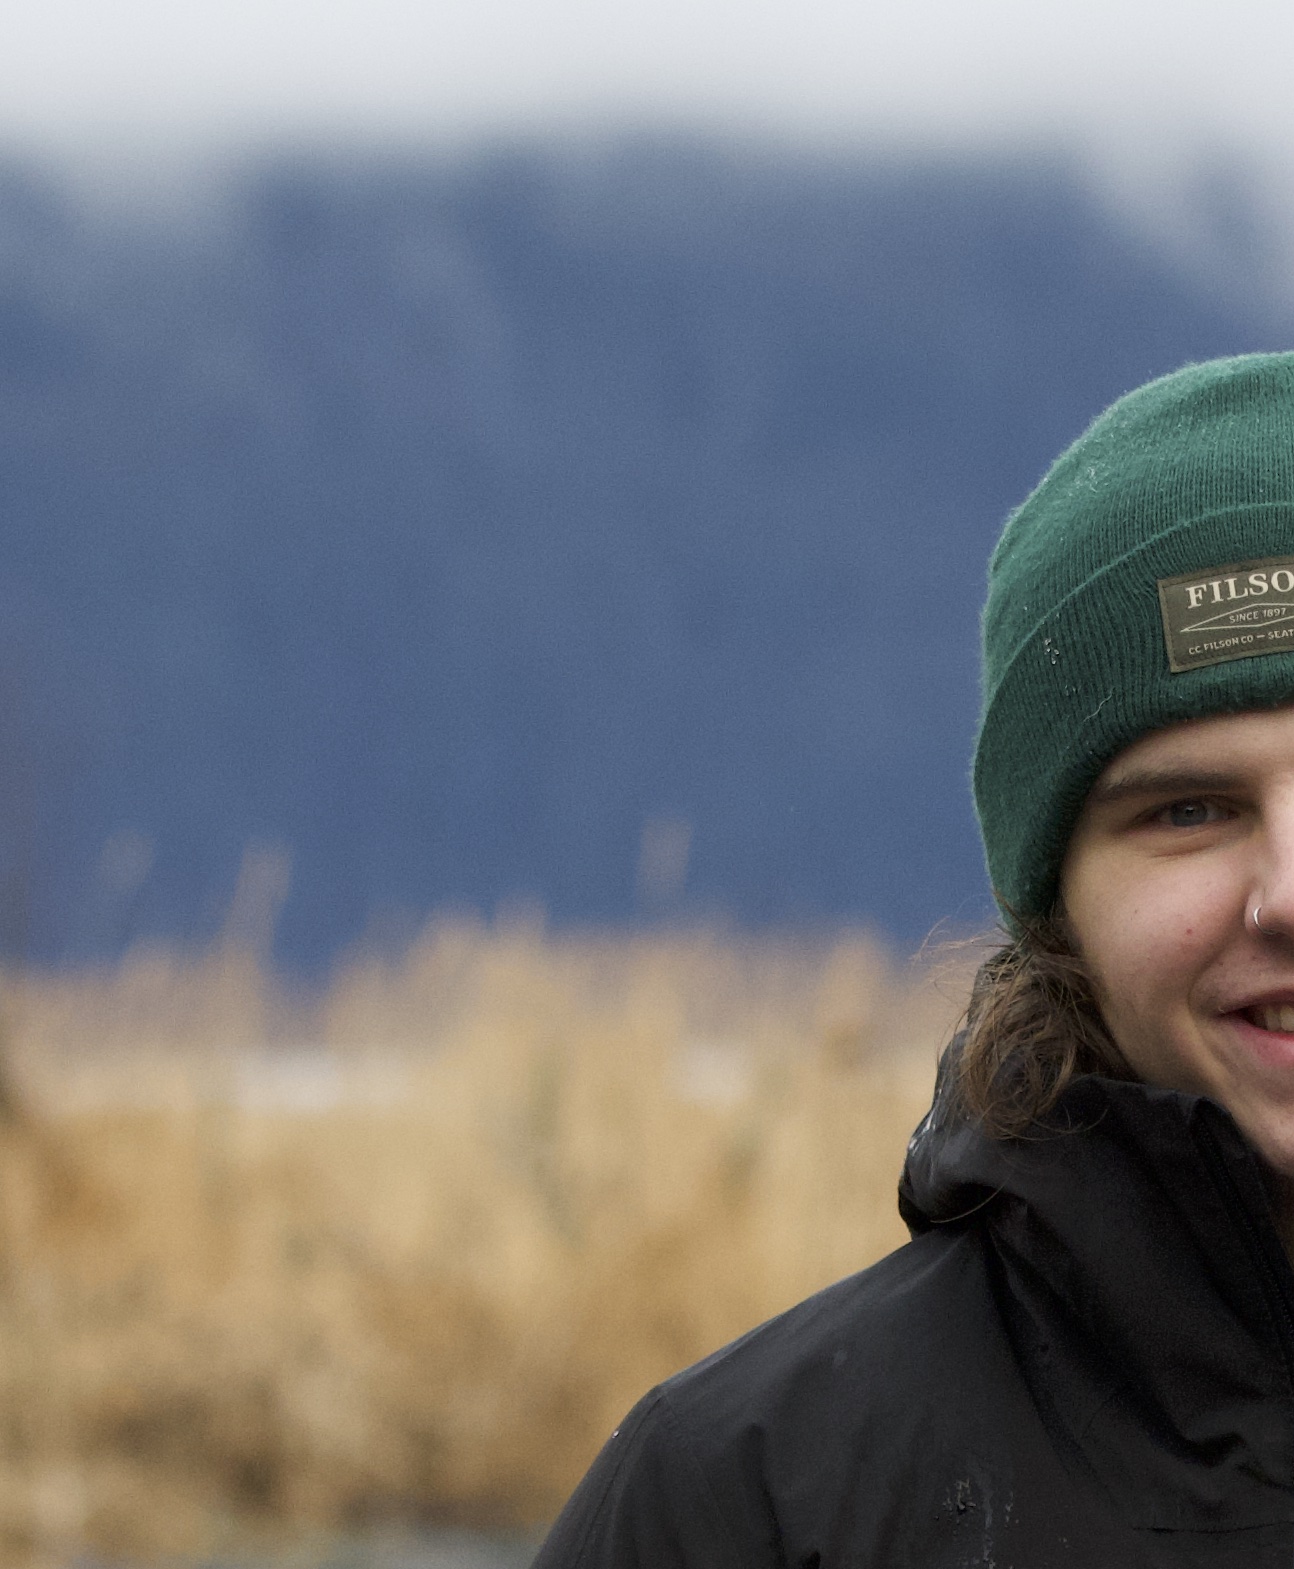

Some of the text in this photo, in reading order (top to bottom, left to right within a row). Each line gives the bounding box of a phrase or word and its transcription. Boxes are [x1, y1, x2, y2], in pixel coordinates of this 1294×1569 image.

[1228, 607, 1287, 624] SINCE 1897
[1203, 636, 1239, 651] FILSON
